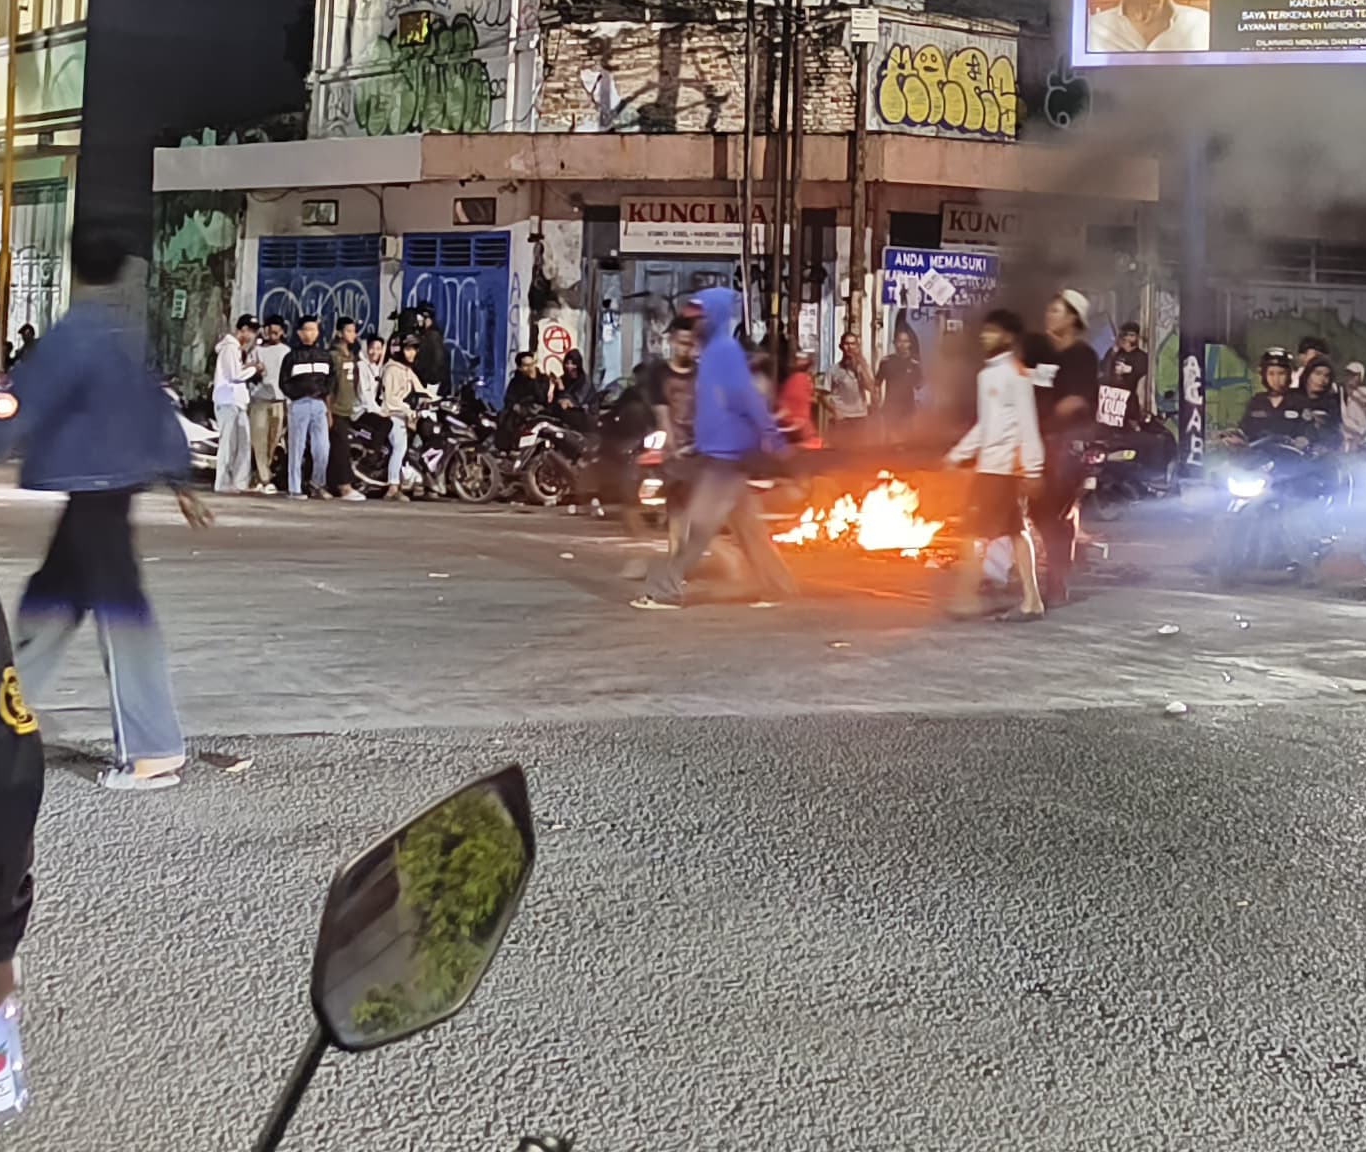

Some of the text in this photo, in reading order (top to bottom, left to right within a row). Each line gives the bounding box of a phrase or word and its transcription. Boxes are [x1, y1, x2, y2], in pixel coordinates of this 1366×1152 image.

[1241, 11, 1266, 20] SAYA
[628, 202, 715, 224] KUNCI
[948, 209, 1025, 234] KUNC
[894, 252, 987, 272] ANDA MEMASUKI
